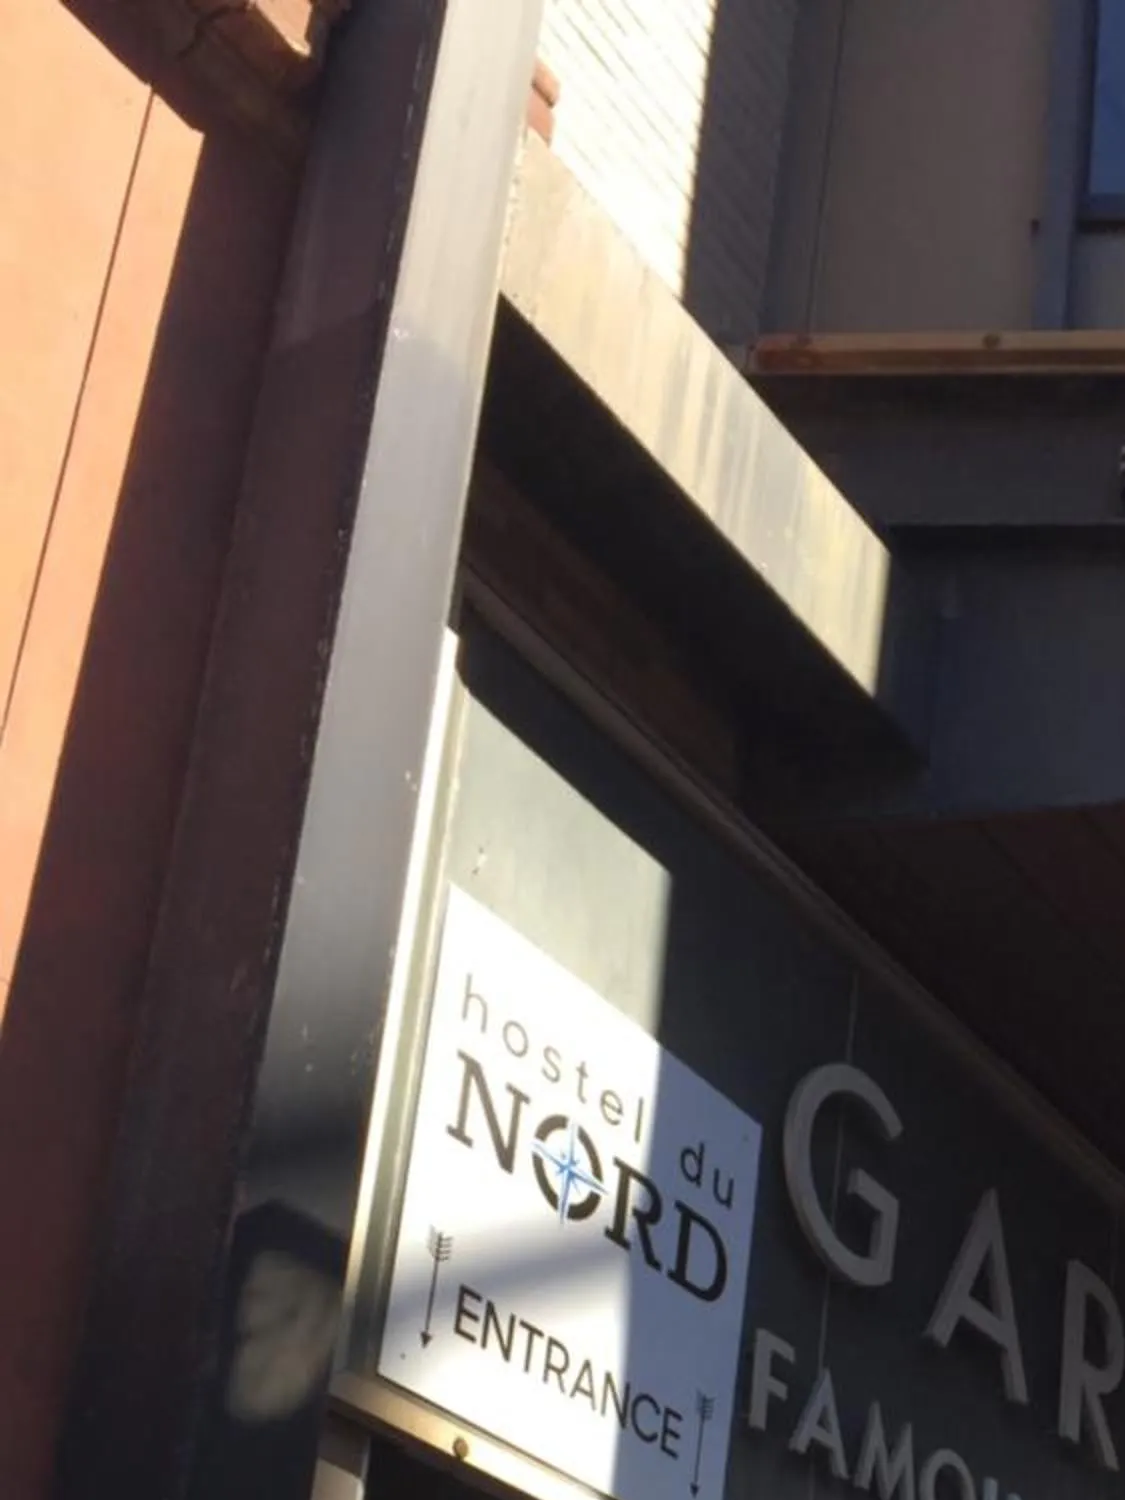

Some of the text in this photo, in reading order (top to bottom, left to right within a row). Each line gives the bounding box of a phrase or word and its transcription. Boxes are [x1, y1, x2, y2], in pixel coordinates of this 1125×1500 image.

[446, 1048, 728, 1302] NORD
[460, 972, 735, 1209] hostel du
[453, 1283, 684, 1460] ENTRANCE
